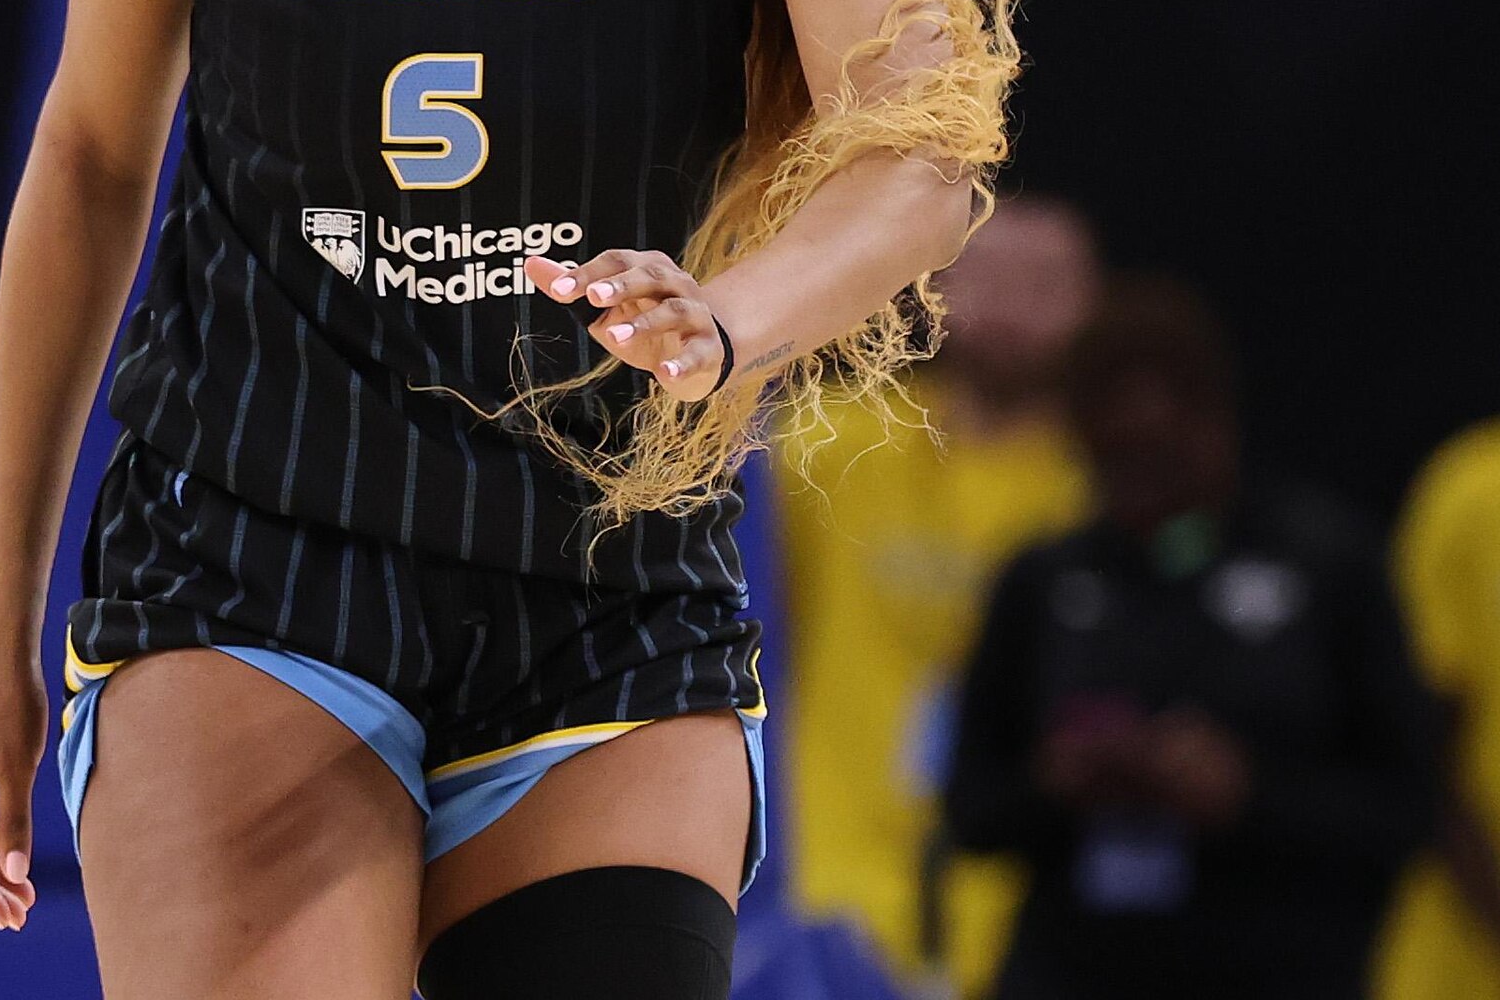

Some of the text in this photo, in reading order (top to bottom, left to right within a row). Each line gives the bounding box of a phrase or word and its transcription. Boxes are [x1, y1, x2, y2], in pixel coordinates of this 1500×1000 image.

[381, 53, 489, 190] 5
[377, 215, 583, 263] UChicago
[375, 257, 580, 304] Medici
